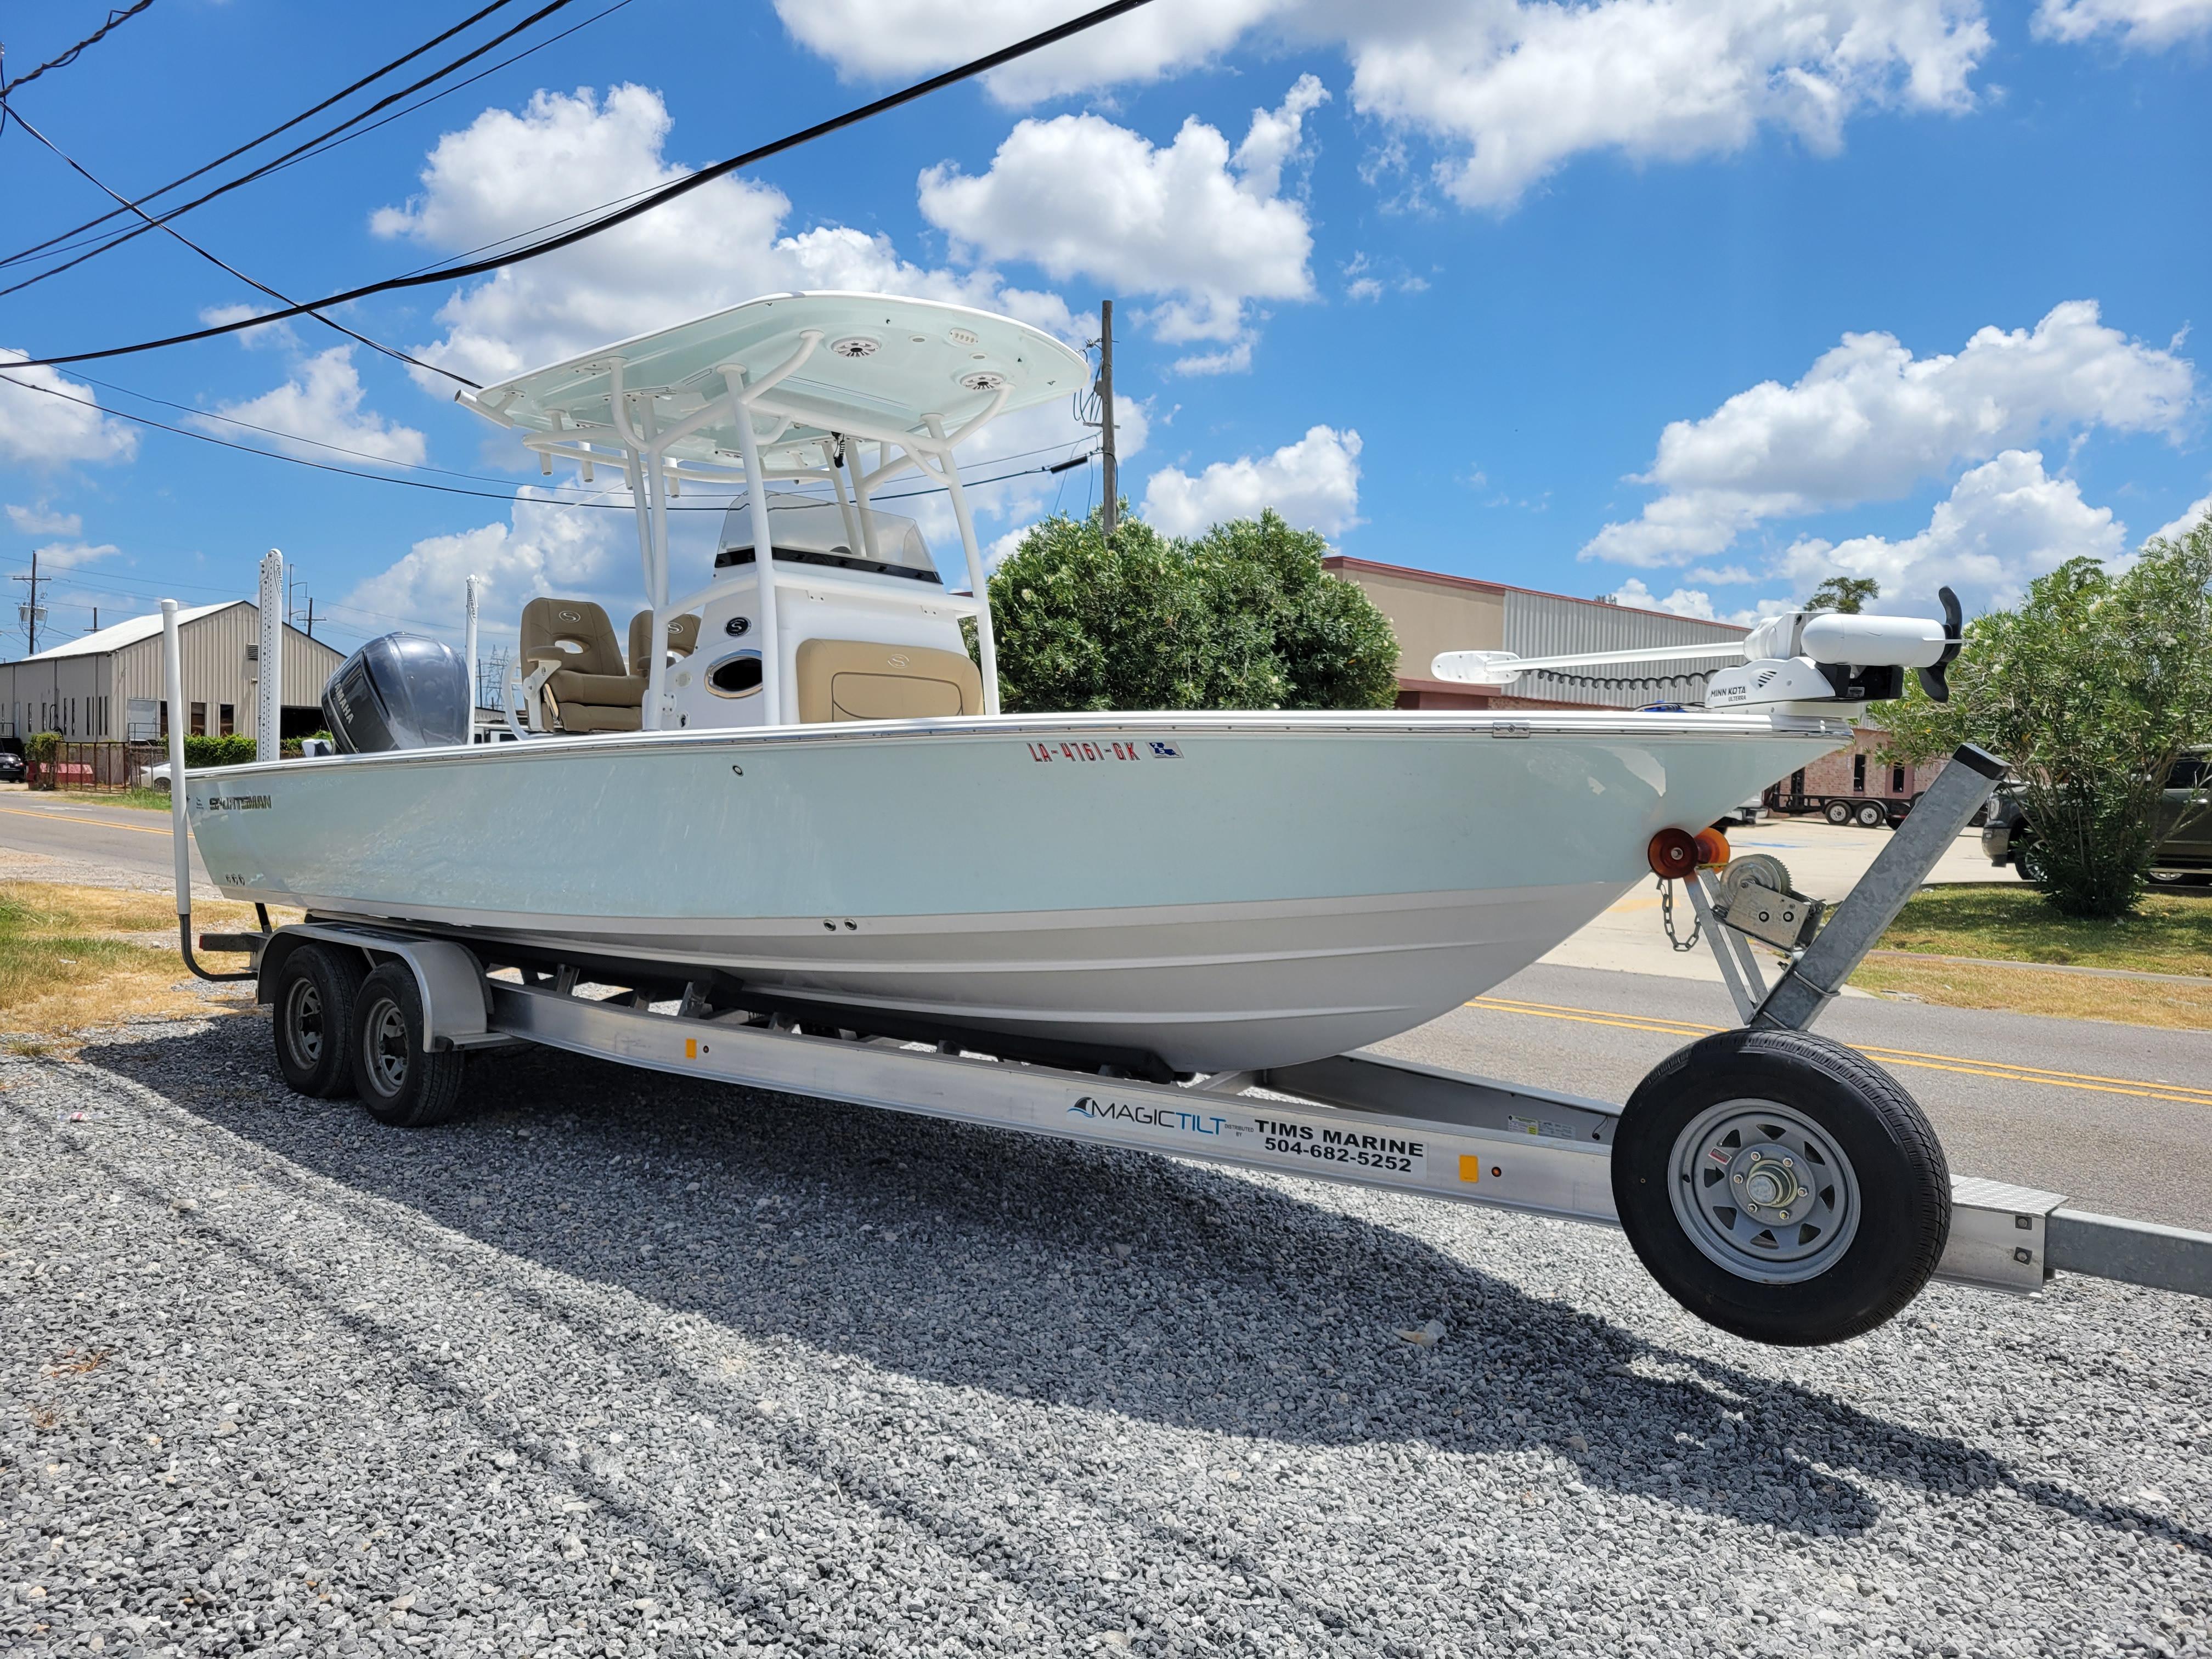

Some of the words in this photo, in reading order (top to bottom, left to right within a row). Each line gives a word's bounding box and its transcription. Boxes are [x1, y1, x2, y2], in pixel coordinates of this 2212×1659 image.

[1711, 688, 1727, 697] MINN
[1728, 686, 1746, 696] KOTA
[209, 794, 272, 811] SPORTSMAN
[1091, 1099, 1227, 1136] MAGICTILT
[1224, 1123, 1255, 1133] DISTRIBUTED
[1255, 1119, 1314, 1140] TIMS
[1323, 1129, 1424, 1158] MARINE
[1265, 1137, 1412, 1173] 504-682-5252
